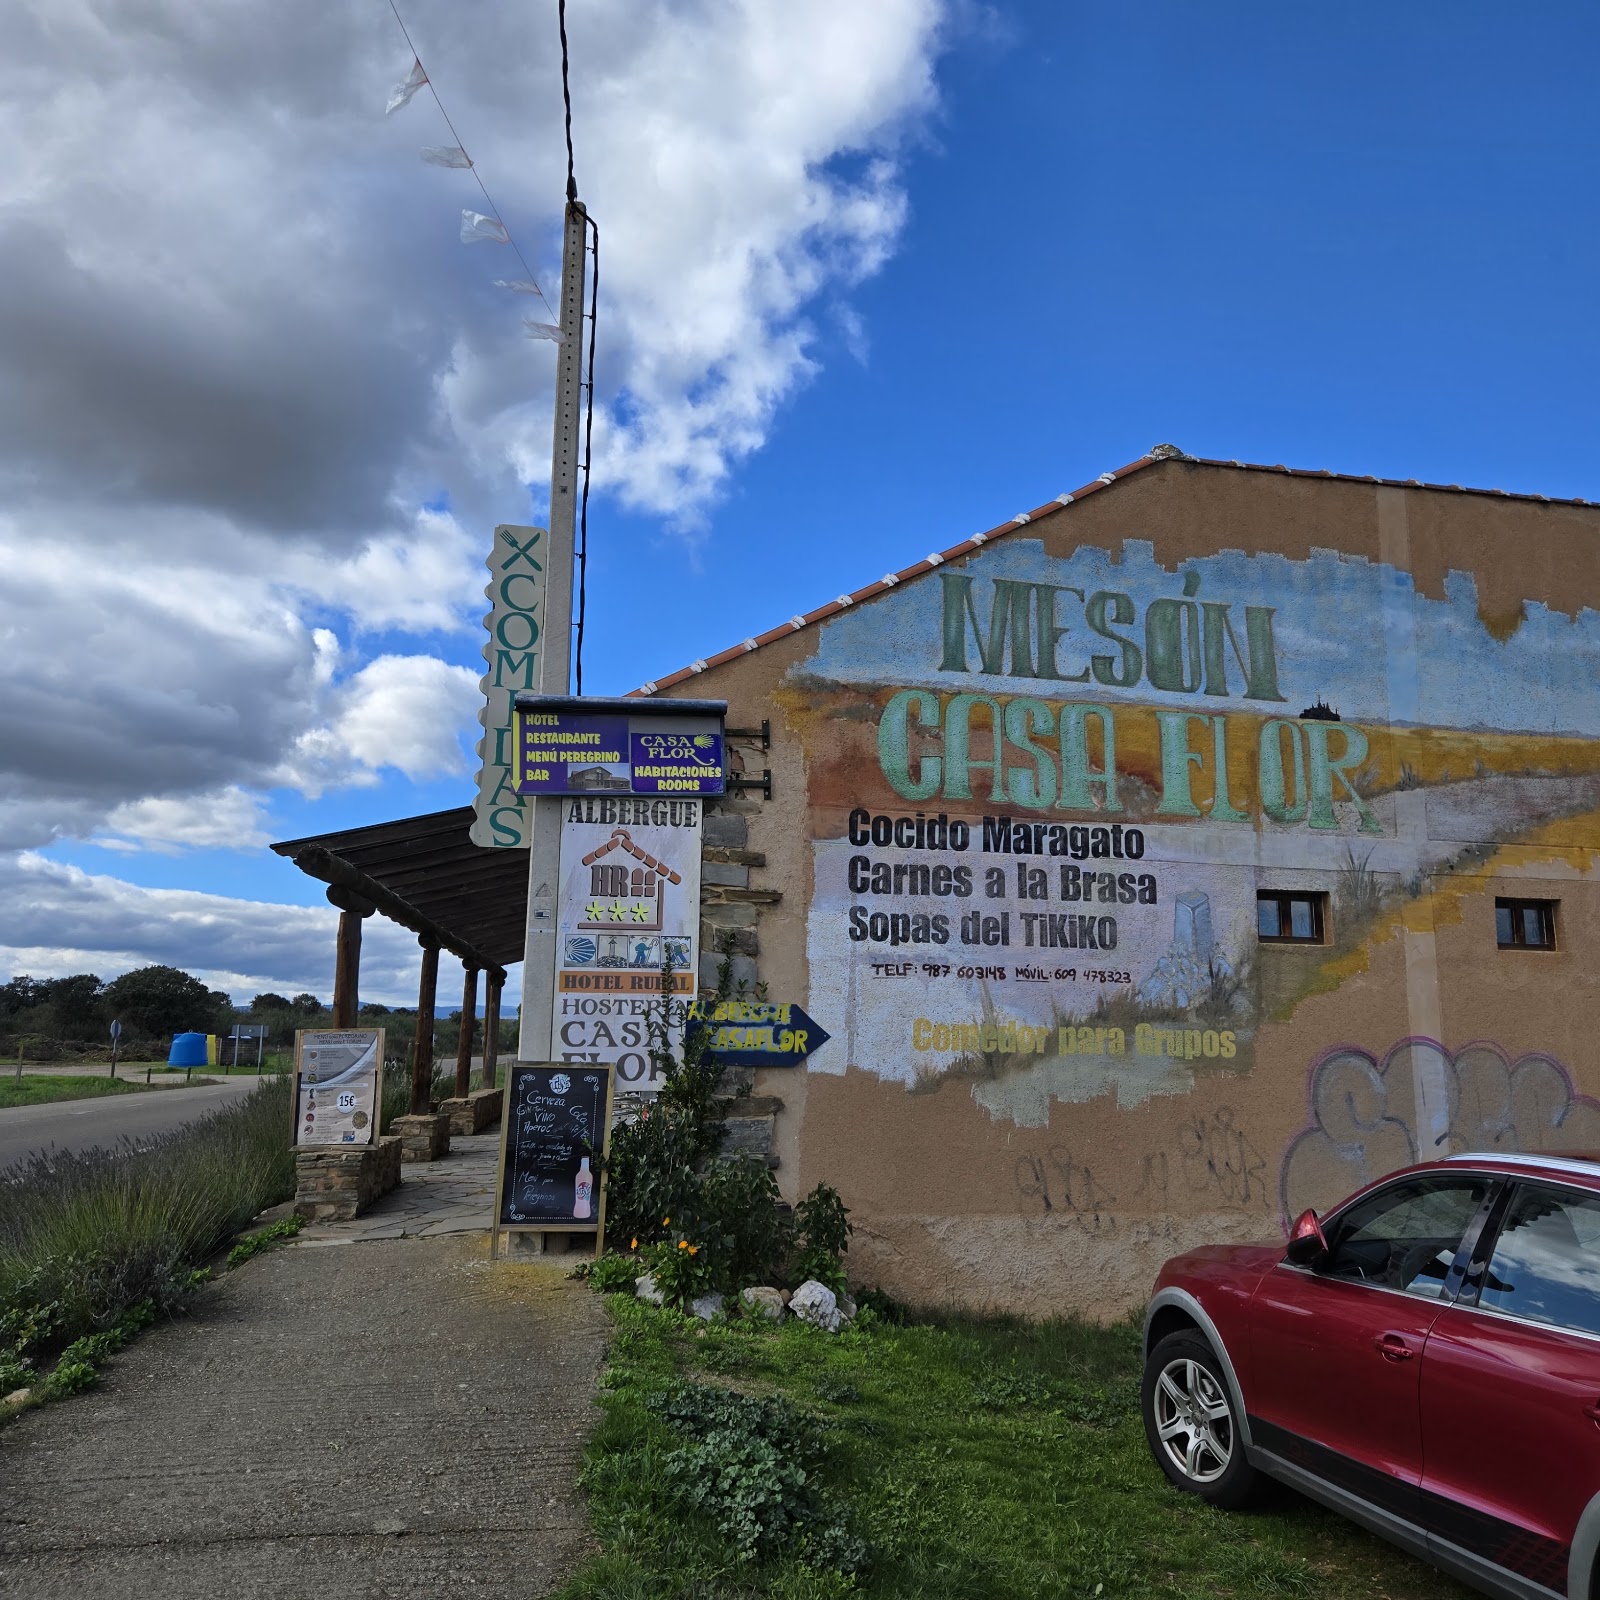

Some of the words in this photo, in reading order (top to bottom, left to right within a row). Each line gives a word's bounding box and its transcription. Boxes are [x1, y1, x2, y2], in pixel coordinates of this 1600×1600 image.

[938, 571, 1288, 702] MESÓN
[525, 714, 560, 726] HOTEL
[525, 732, 601, 745] RESTAURANTE
[640, 735, 692, 747] CASA
[525, 747, 557, 763] MENÚ
[559, 751, 620, 763] PEREGRINO
[648, 747, 716, 766] FLOR
[878, 689, 1124, 812] CASA
[1156, 710, 1385, 834] FLOR
[525, 769, 550, 781] BAR
[634, 766, 722, 778] HABITACIONES
[657, 779, 700, 791] ROOMS
[567, 798, 698, 828] ALBERGUE
[848, 808, 970, 851] Cocido
[982, 816, 1145, 860] Maragato
[848, 855, 973, 898] Carnes
[985, 866, 1006, 899] a
[1017, 862, 1048, 900] la
[1060, 864, 1158, 905] Brasa
[848, 905, 950, 946] Sopas
[960, 910, 1010, 946] del
[563, 974, 624, 990] HOTEL
[630, 975, 690, 991] RURAL
[922, 964, 951, 978] 987
[957, 966, 1007, 981] 603148
[1054, 968, 1077, 982] 609
[1083, 969, 1132, 984] 478323
[561, 998, 688, 1028] HOSTERA
[560, 1020, 674, 1048] CASA
[912, 1017, 1049, 1053] Comedor
[1058, 1026, 1125, 1057] para
[1135, 1023, 1237, 1060] Grupos
[339, 1095, 355, 1107] 15€
[526, 1089, 566, 1107] Cerveza
